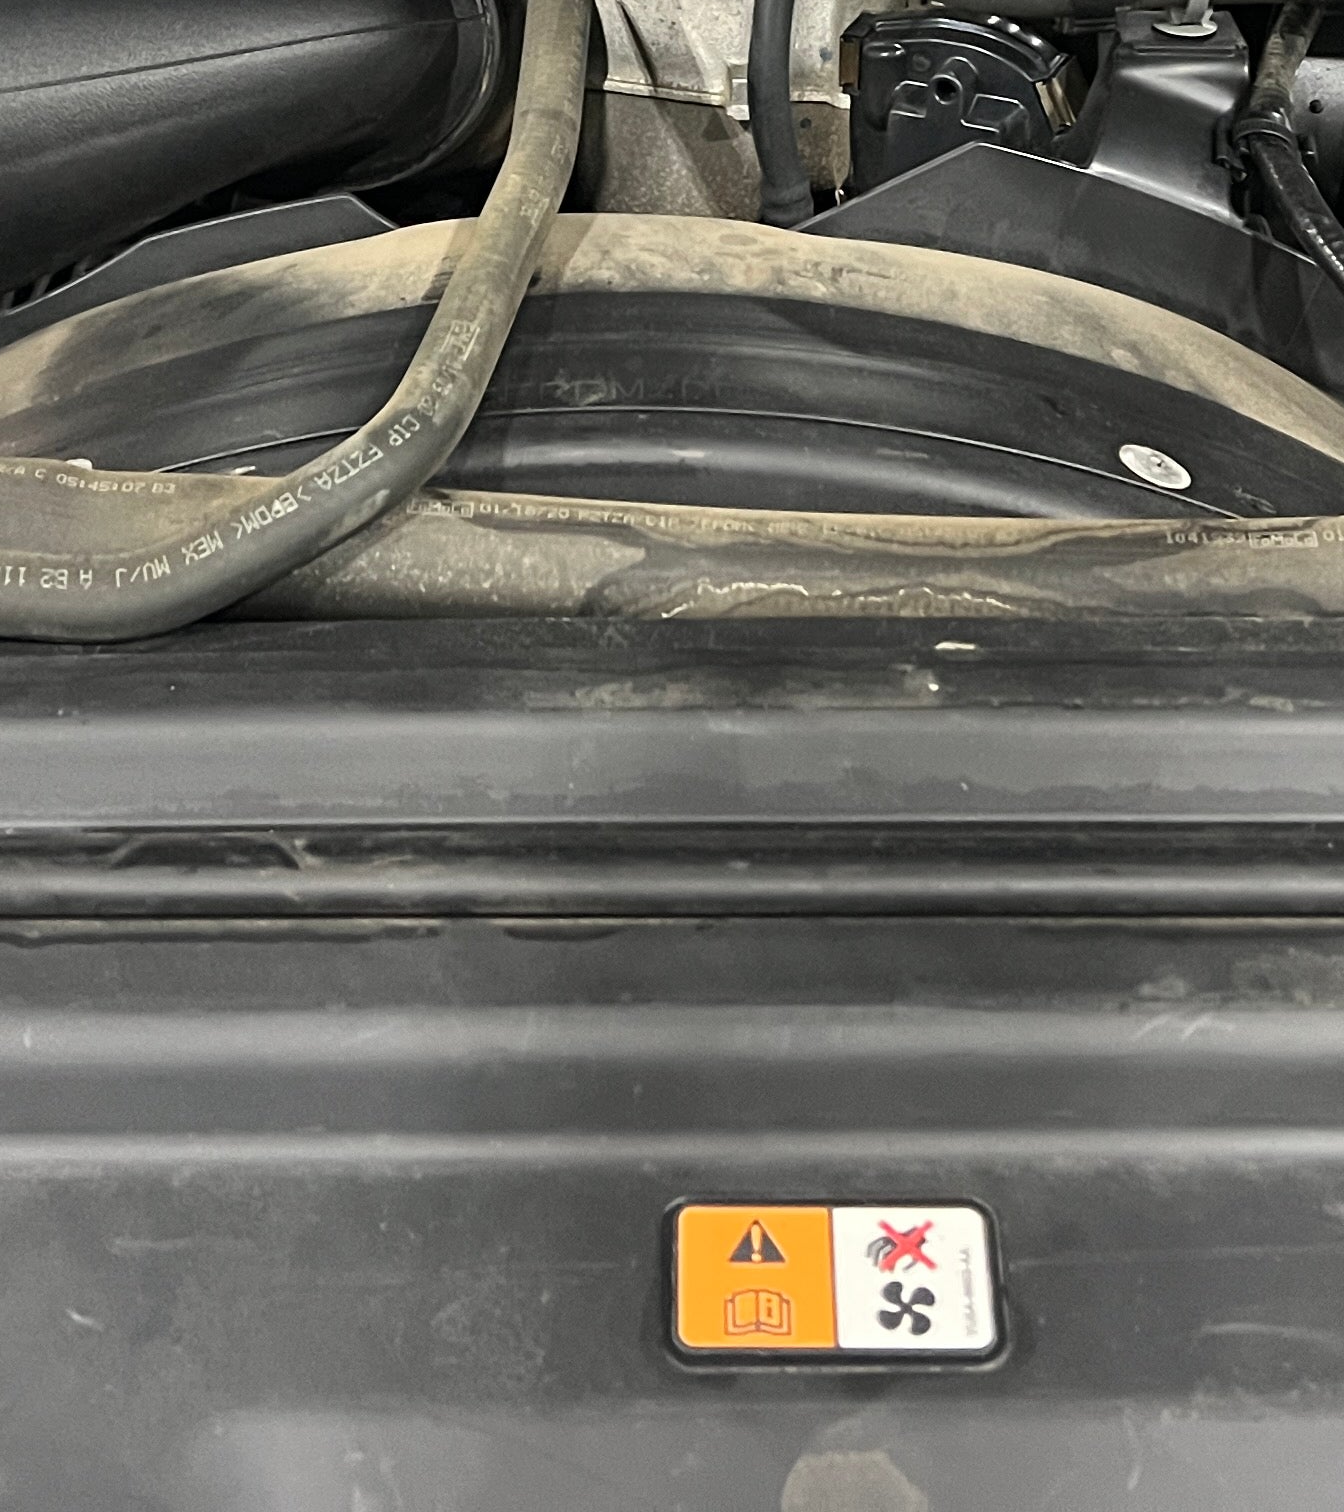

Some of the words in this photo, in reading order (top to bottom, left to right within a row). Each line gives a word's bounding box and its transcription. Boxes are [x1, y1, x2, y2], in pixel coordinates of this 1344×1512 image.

[389, 414, 422, 448] CIP
[181, 529, 225, 565] MEX
[80, 566, 94, 589] A
[116, 554, 172, 586] MU/J
